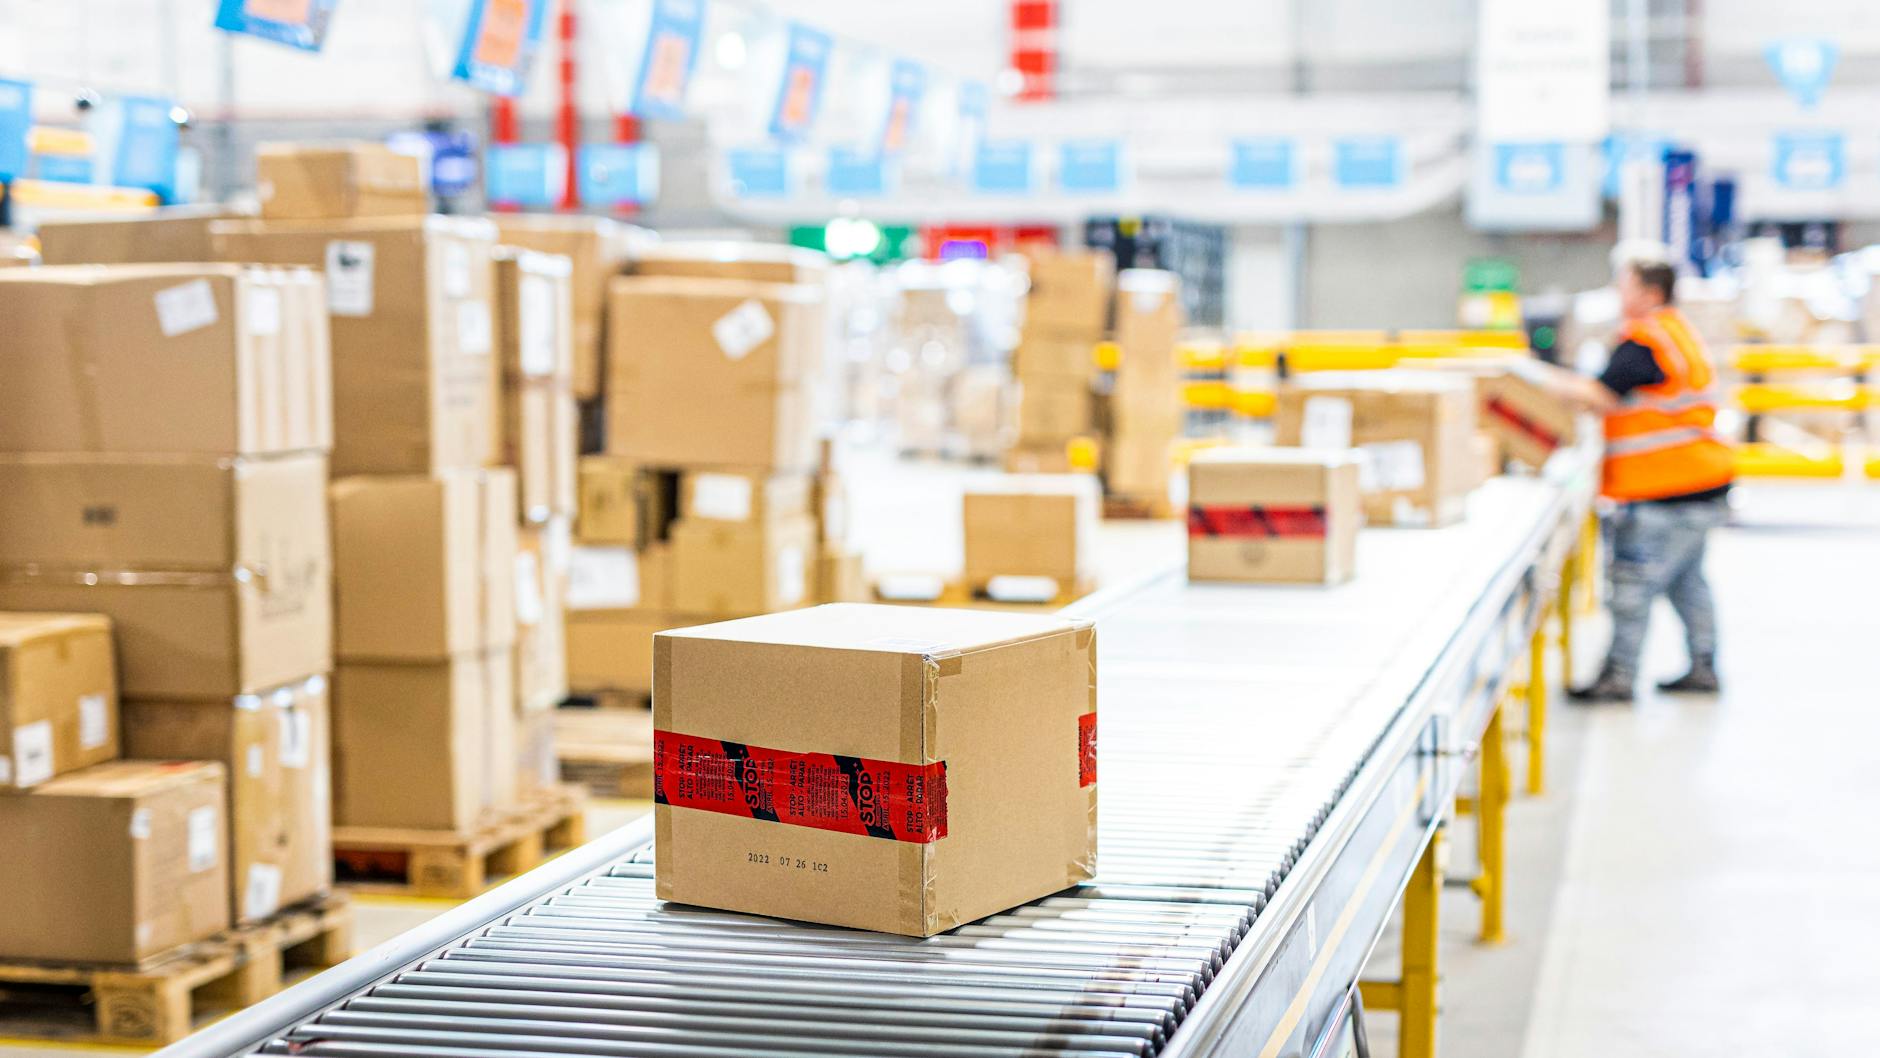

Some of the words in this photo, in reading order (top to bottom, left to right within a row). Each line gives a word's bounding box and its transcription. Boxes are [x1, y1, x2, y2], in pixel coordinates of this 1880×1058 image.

[745, 759, 758, 807] STOP
[798, 760, 806, 788] PARAR
[860, 771, 874, 824] STOP
[915, 775, 924, 804] PARAR
[789, 794, 797, 816] STOP
[906, 810, 914, 833] STOP
[915, 812, 923, 834] ALTO
[748, 852, 770, 864] 2022
[779, 856, 791, 867] 07
[795, 859, 807, 869] 26
